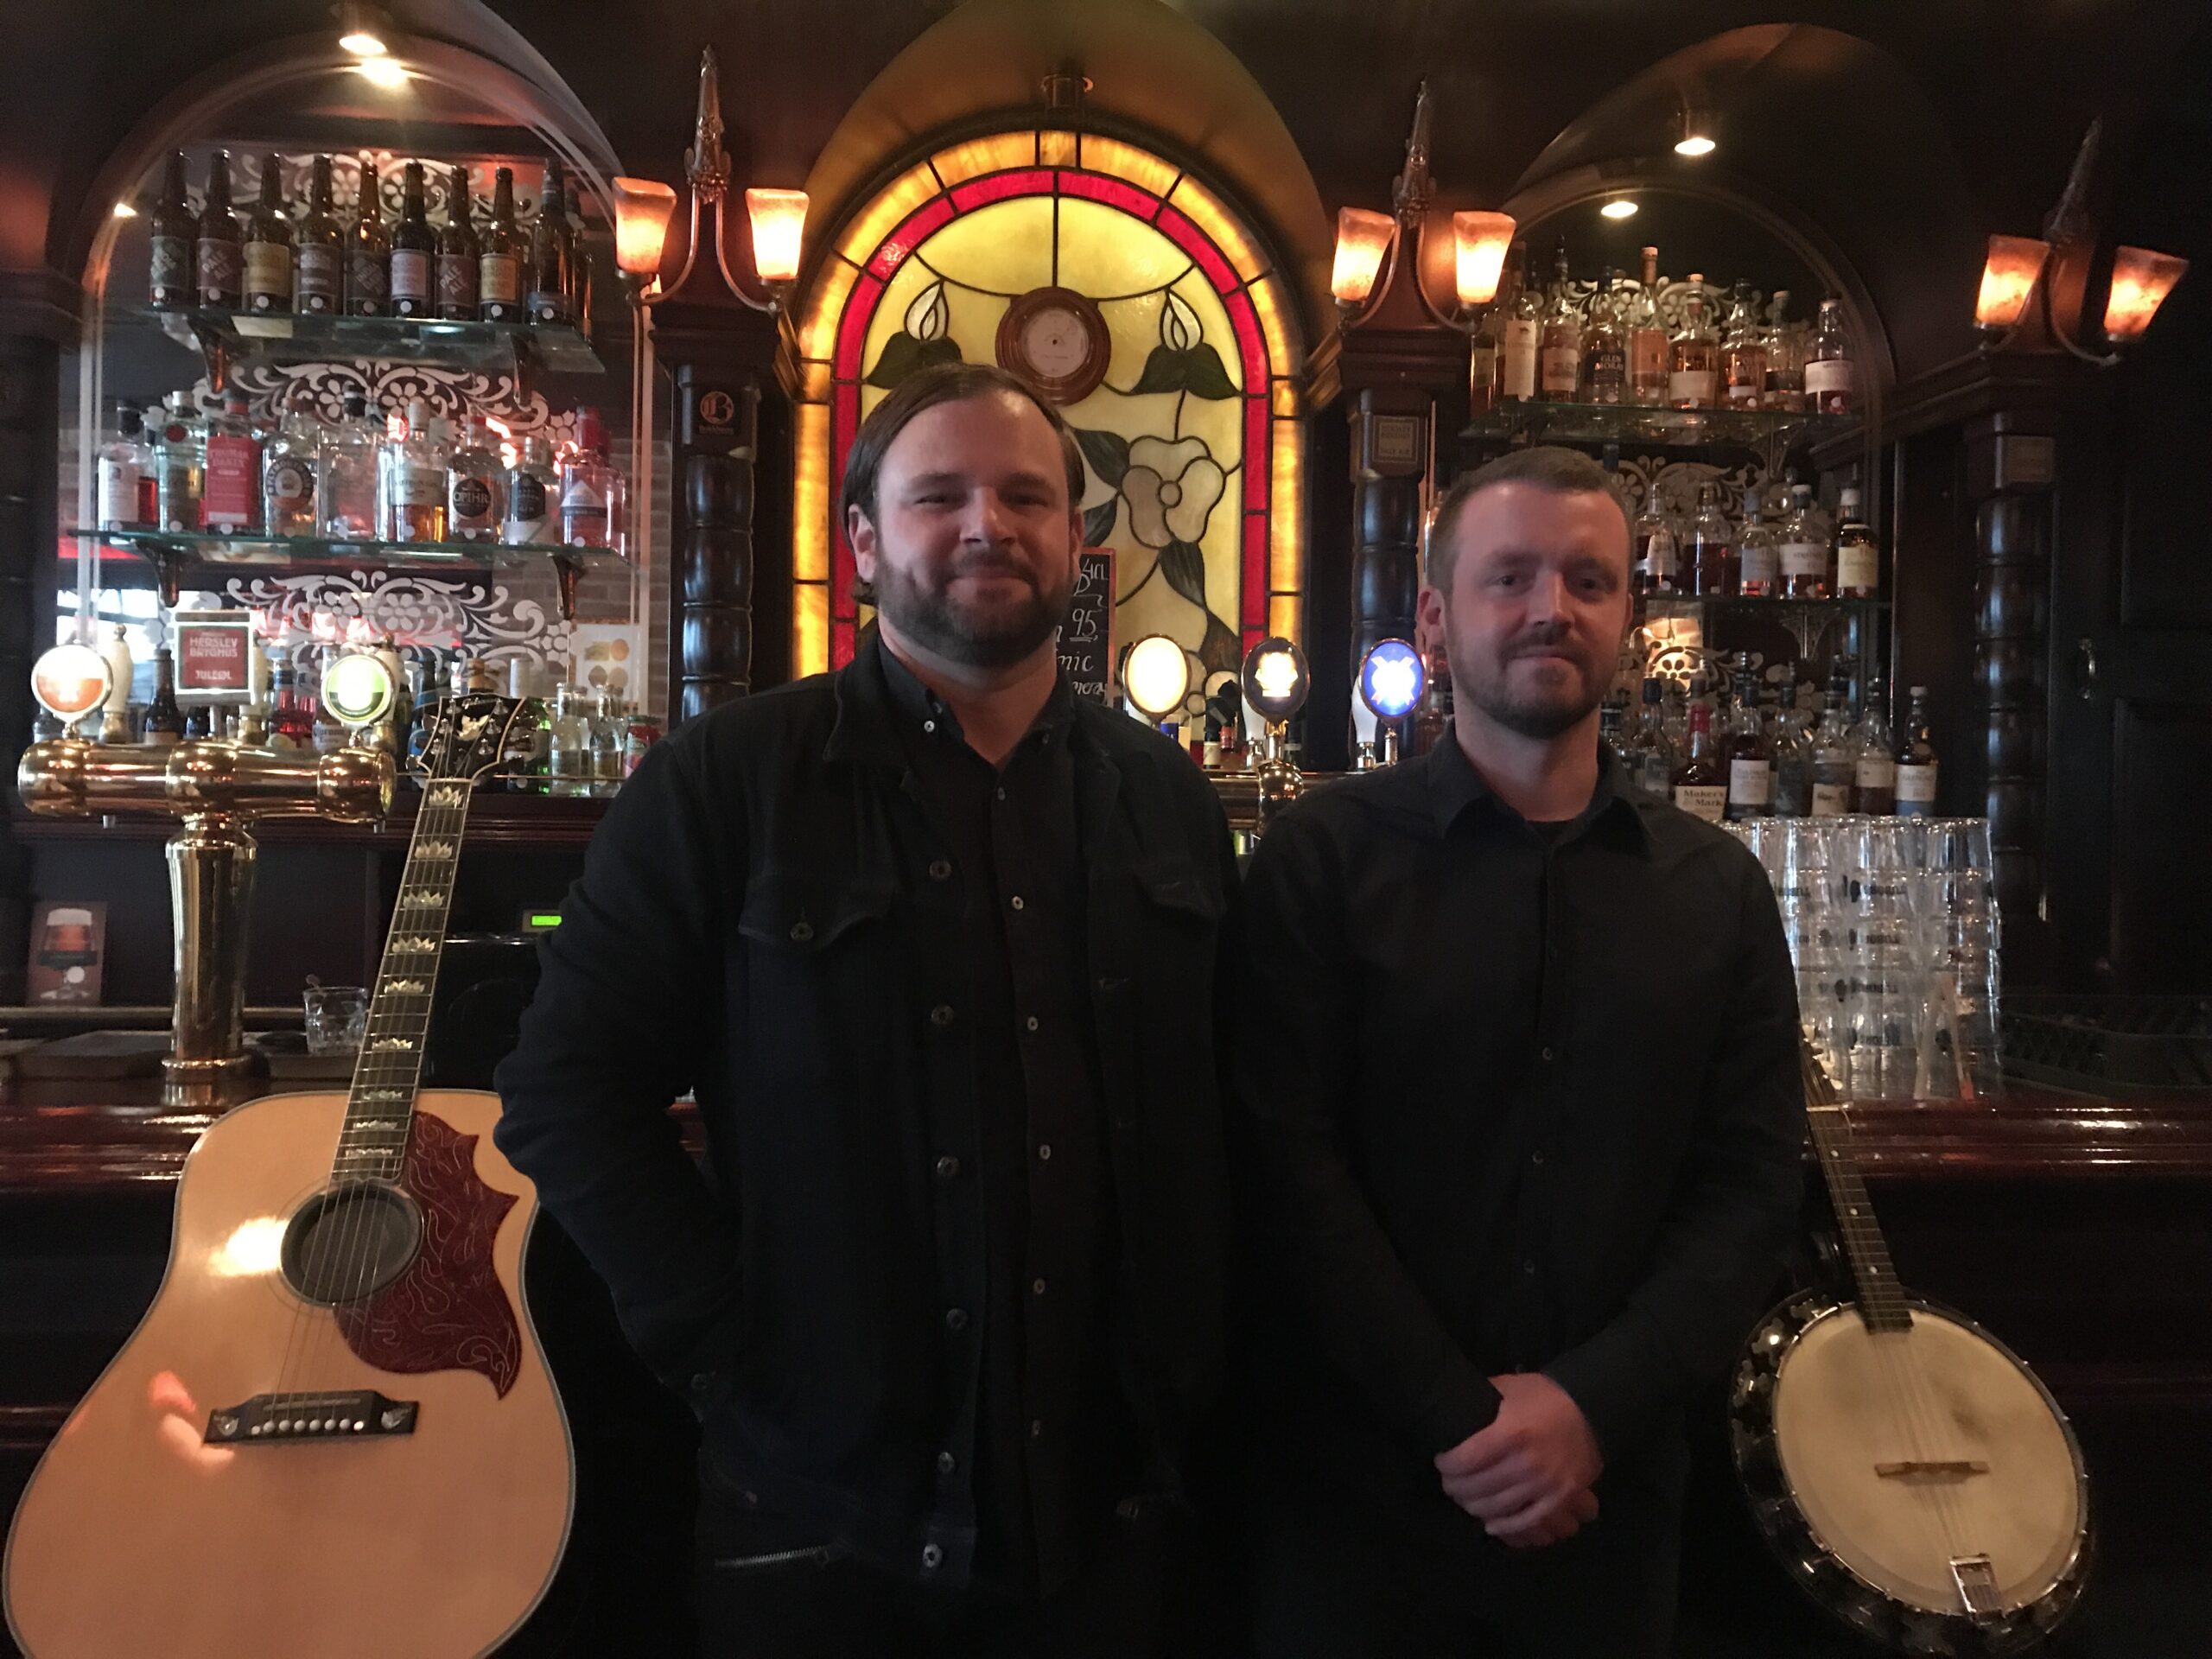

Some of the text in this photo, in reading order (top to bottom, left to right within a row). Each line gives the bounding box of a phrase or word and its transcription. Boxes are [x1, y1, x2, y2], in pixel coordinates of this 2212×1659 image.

[439, 264, 463, 289] PALE
[189, 636, 238, 647] HERSLEV
[1057, 651, 1094, 672] nic
[1695, 798, 1722, 807] Mark
